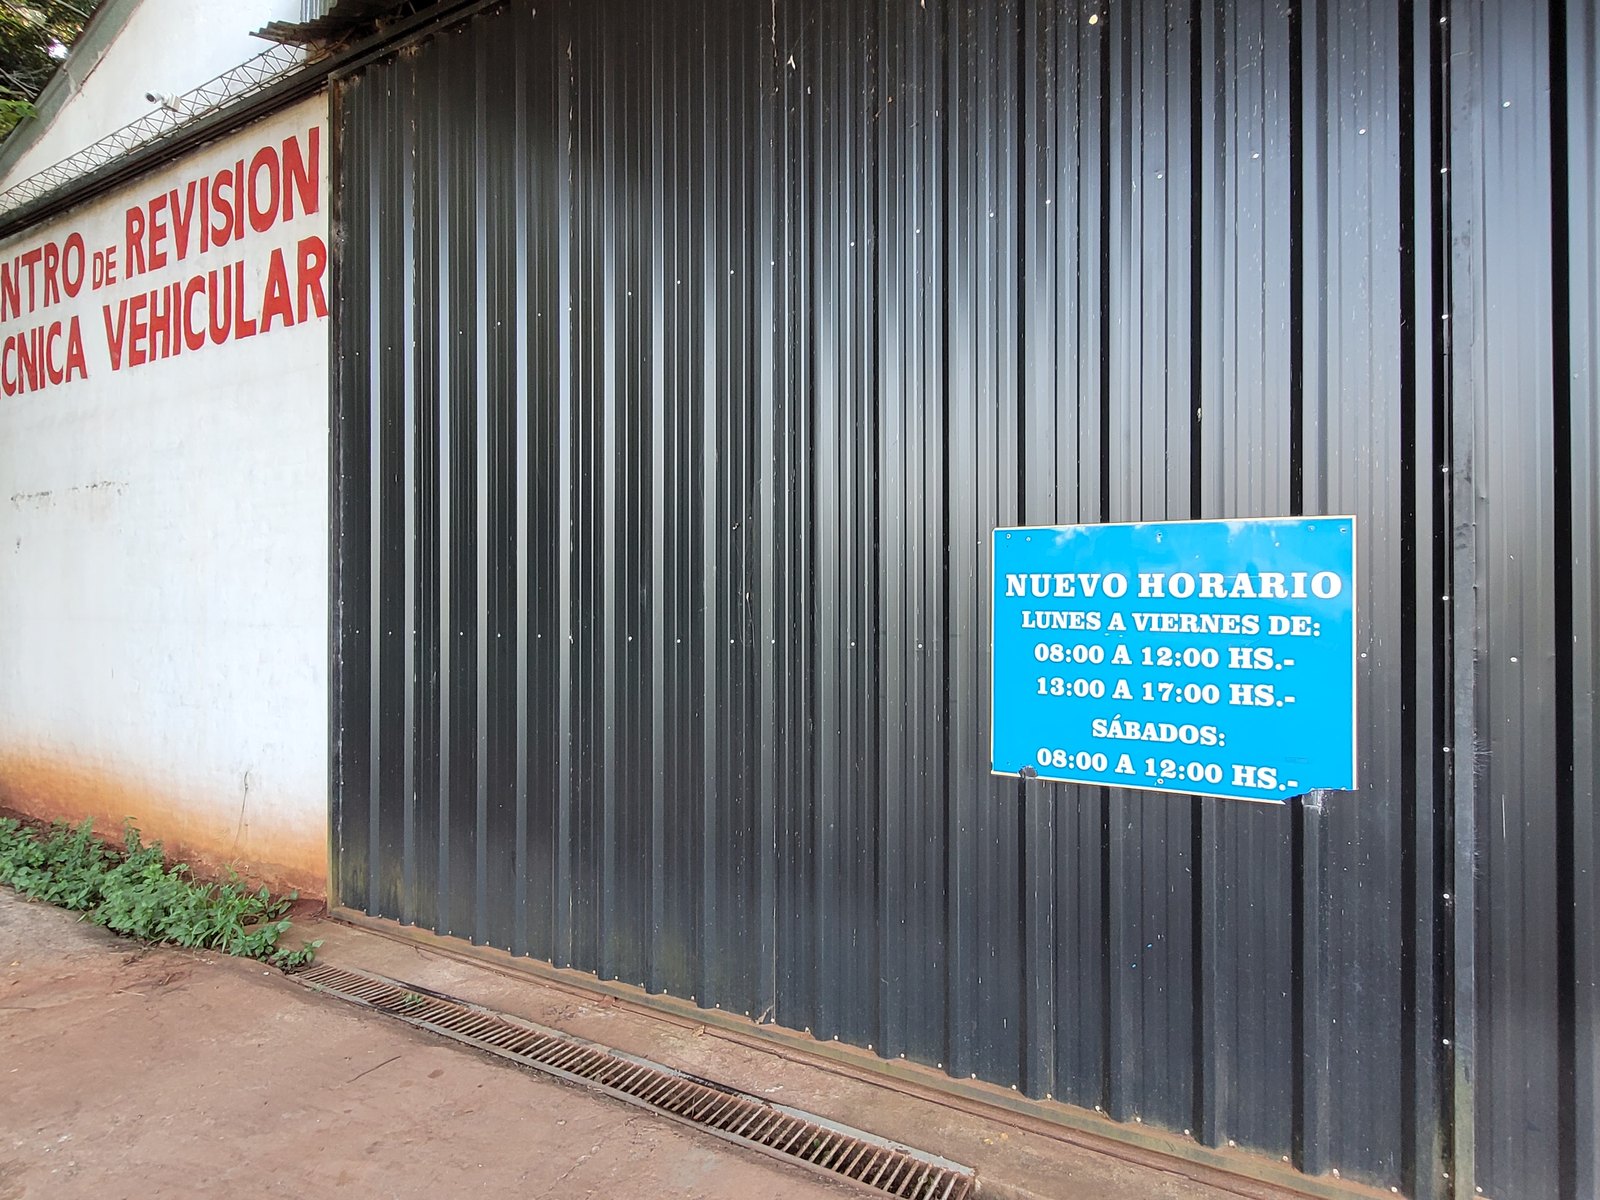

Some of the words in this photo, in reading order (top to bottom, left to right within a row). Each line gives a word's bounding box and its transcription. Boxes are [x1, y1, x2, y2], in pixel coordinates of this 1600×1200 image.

[91, 245, 117, 290] DE
[125, 126, 320, 280] REVISION
[0, 315, 88, 398] CNICA
[102, 235, 329, 371] VEHICULAR
[1005, 572, 1128, 598] NUEVO
[1137, 571, 1342, 599] HORARIO
[1021, 610, 1102, 630] LUNES
[1107, 613, 1126, 631] A
[1132, 612, 1260, 635] VIERNES
[1268, 615, 1322, 637] DE:
[1034, 643, 1105, 664] 08:00
[1111, 645, 1132, 666] A
[1141, 647, 1219, 668] 12:00
[1036, 677, 1105, 698] 13:00
[1112, 679, 1132, 700] A
[1142, 682, 1220, 705] 17:00
[1091, 714, 1226, 747] SÁBADOS:
[1036, 747, 1108, 772] 08:00
[1115, 754, 1136, 776] A
[1144, 758, 1223, 785] 12:00
